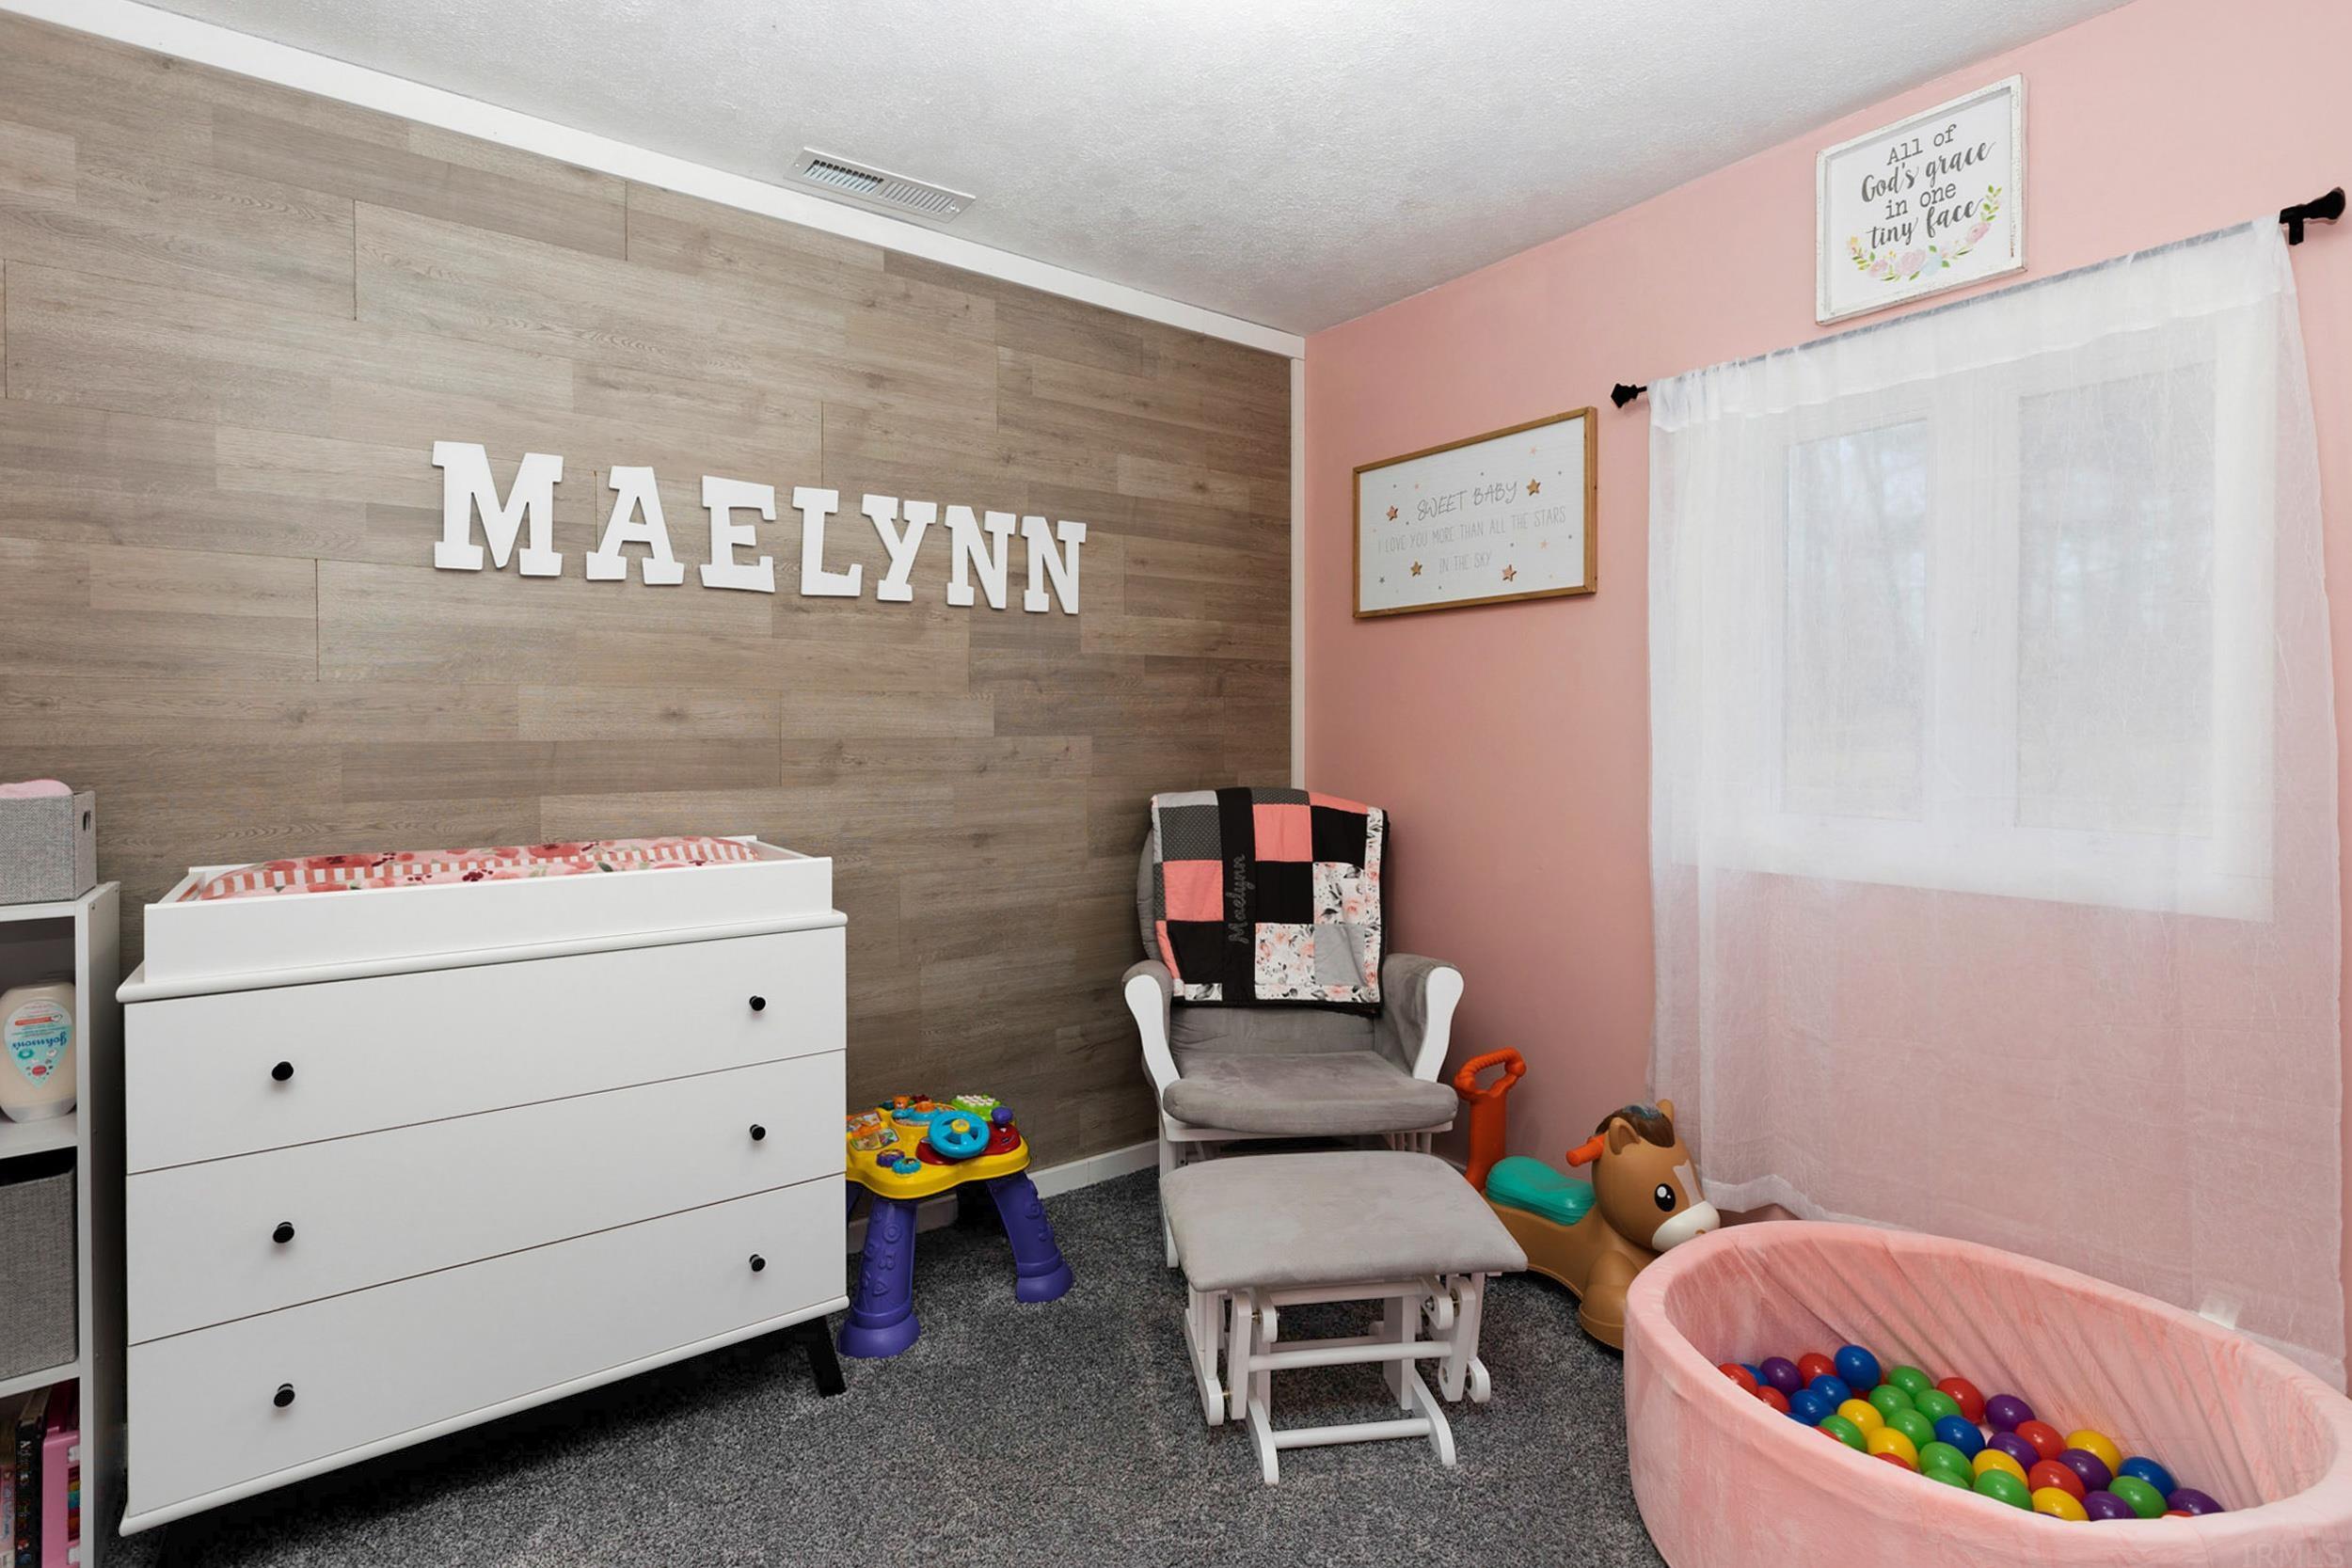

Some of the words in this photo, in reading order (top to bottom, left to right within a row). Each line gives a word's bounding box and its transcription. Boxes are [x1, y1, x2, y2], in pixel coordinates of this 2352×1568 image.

[1886, 138, 1924, 166] All
[1933, 123, 1957, 147] of
[1861, 162, 1919, 203] God's
[1926, 141, 1996, 187] grace
[1866, 217, 1918, 249] tiny
[1926, 198, 1984, 239] face
[1884, 199, 1909, 220] in
[1920, 182, 1957, 208] one
[1417, 490, 1468, 521] SWEET
[1473, 481, 1518, 506] BABY
[432, 440, 1087, 615] MAELYNN
[1385, 534, 1406, 553] LOVE
[1410, 531, 1428, 548] YOU
[1432, 526, 1454, 545] MORE
[1460, 522, 1484, 540] THAN
[1488, 517, 1506, 535] ALL
[1511, 513, 1529, 531] THE
[1534, 505, 1566, 529] STARS
[1438, 557, 1450, 575] IN
[1453, 553, 1470, 572] THE
[1473, 549, 1492, 569] SKY
